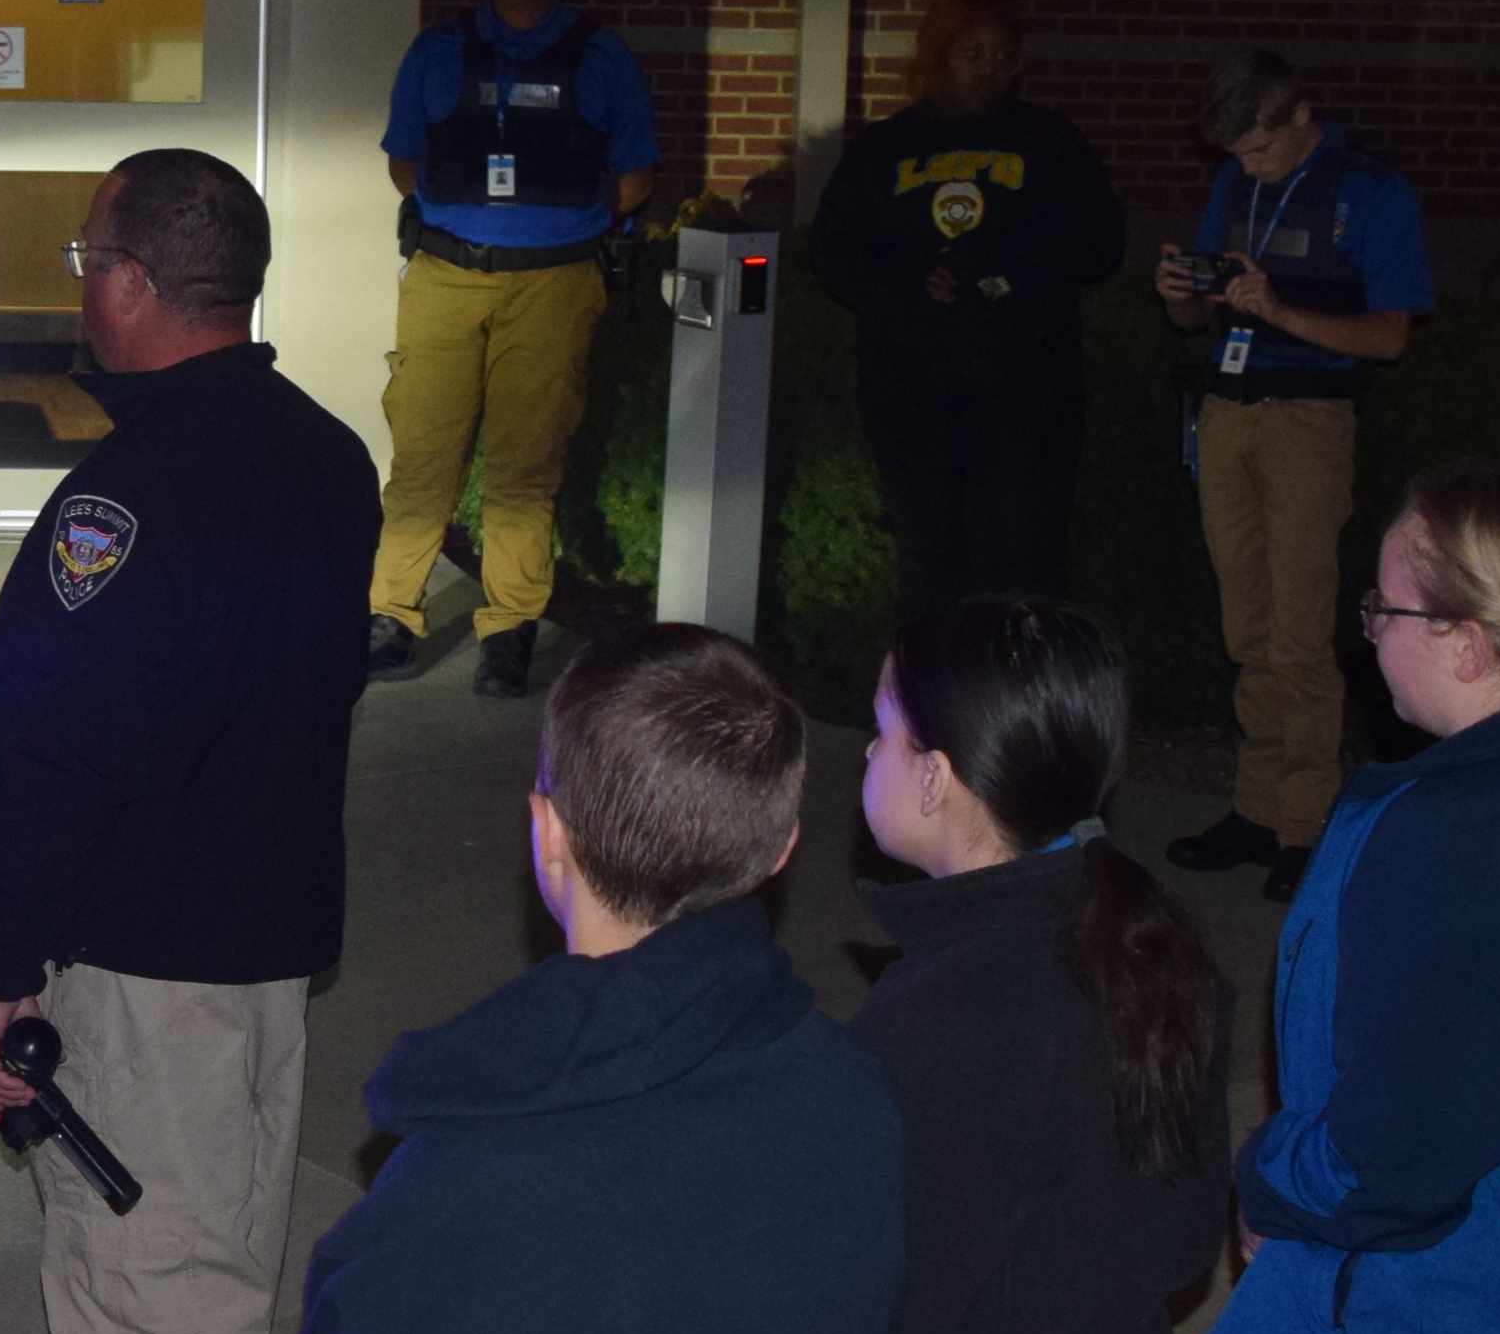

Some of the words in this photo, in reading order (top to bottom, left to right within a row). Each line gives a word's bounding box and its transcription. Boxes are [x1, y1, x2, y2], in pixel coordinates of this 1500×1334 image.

[64, 502, 92, 518] LEE'S
[94, 505, 131, 533] SUMMIT
[58, 567, 94, 601] POLICE
